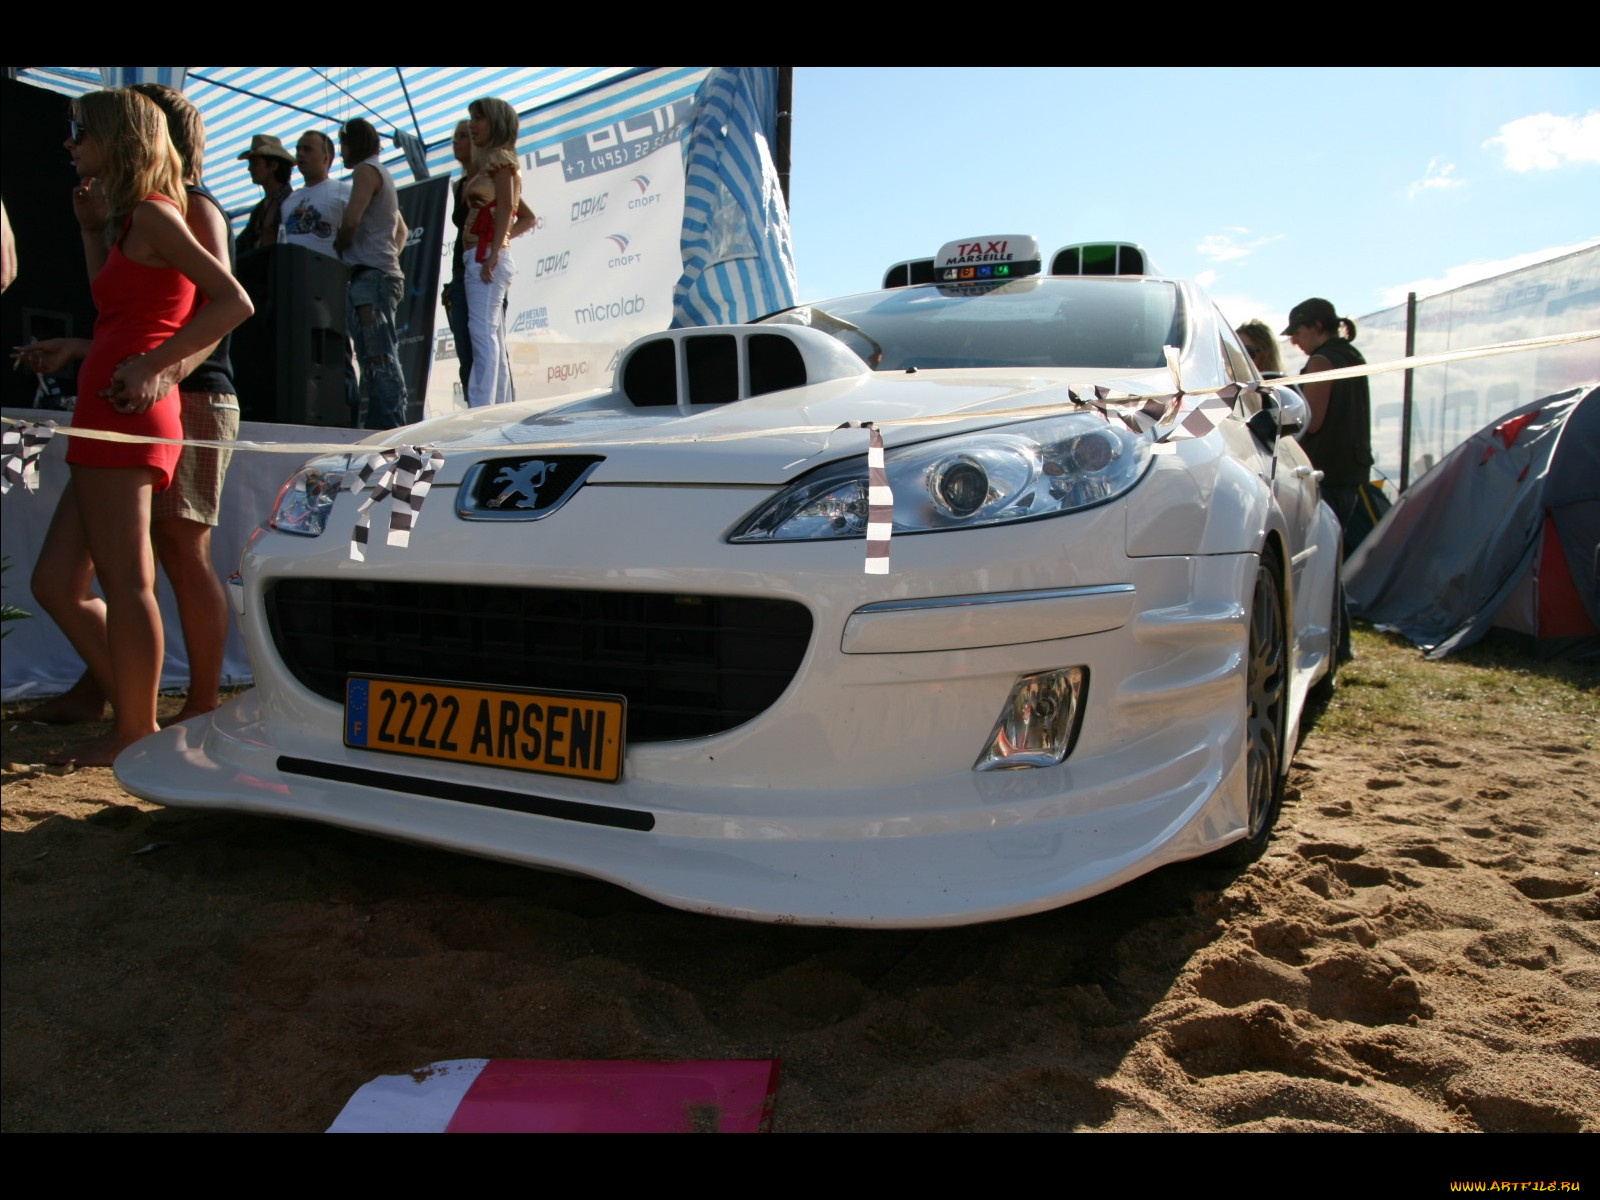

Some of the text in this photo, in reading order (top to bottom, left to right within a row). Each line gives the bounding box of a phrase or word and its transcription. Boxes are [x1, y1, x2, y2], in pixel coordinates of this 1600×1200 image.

[591, 149, 629, 170] (495)
[571, 192, 609, 222] ОФИС
[628, 194, 662, 210] СПОРТ
[957, 241, 1009, 256] TAXI
[535, 250, 571, 278] ОФИС
[608, 253, 641, 268] СПОРТ
[946, 253, 1014, 266] MARSEILLE
[574, 294, 645, 325] microlab
[354, 721, 363, 737] F
[377, 688, 606, 771] 2222 ARSENI
